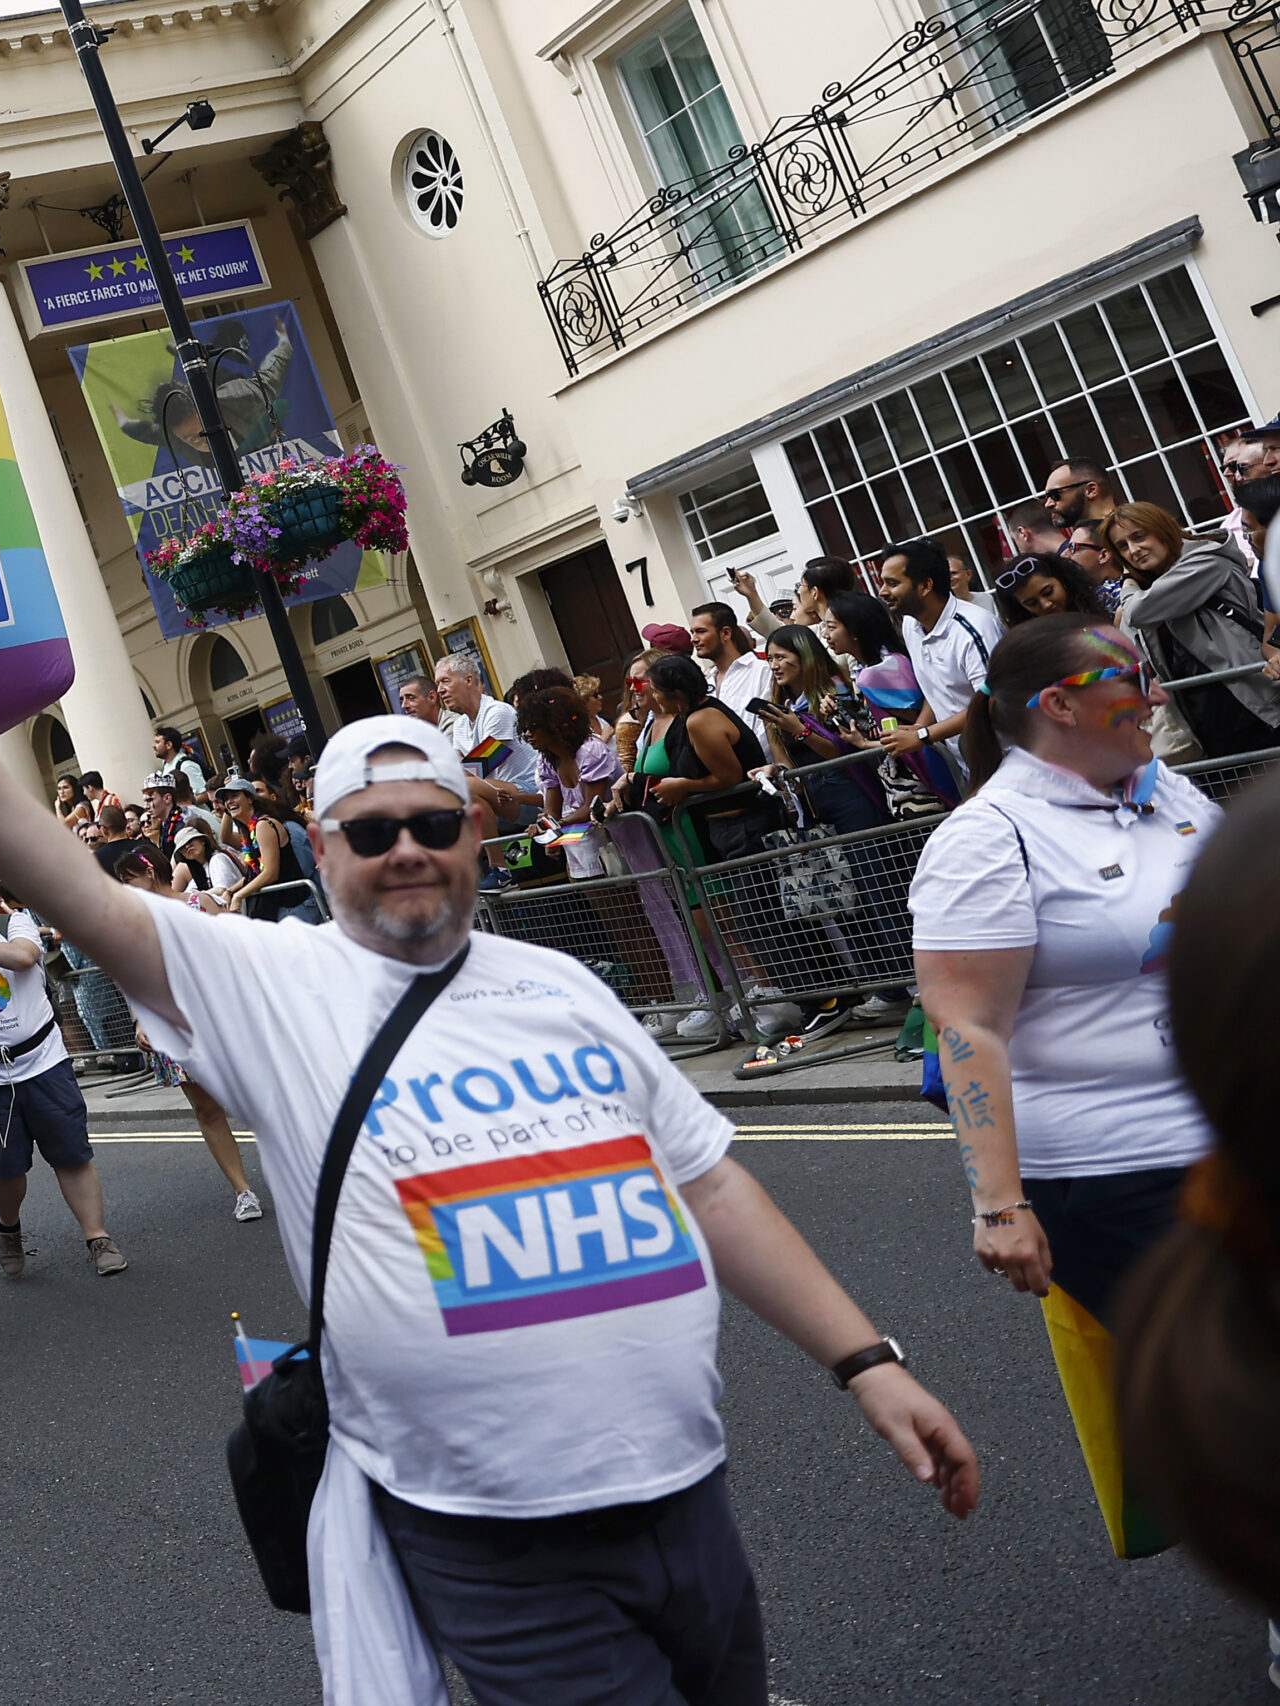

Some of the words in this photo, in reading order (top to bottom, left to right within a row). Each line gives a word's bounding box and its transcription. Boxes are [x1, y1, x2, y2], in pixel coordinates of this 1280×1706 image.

[56, 290, 90, 307] FIERCE
[91, 285, 123, 302] FARCE
[124, 282, 138, 295] TO
[174, 271, 188, 286] HE
[188, 268, 208, 282] MET
[478, 454, 494, 468] OSCAR
[495, 452, 512, 460] WILDE
[492, 472, 512, 482] ROOM
[149, 496, 217, 539] DEATH
[626, 556, 655, 607] 7
[1104, 868, 1121, 878] NHS
[450, 989, 487, 1002] Guy's
[382, 1141, 417, 1167] to
[425, 1132, 476, 1158] be
[488, 1115, 558, 1153] part
[564, 1102, 596, 1132] of
[455, 1173, 676, 1289] NHS
